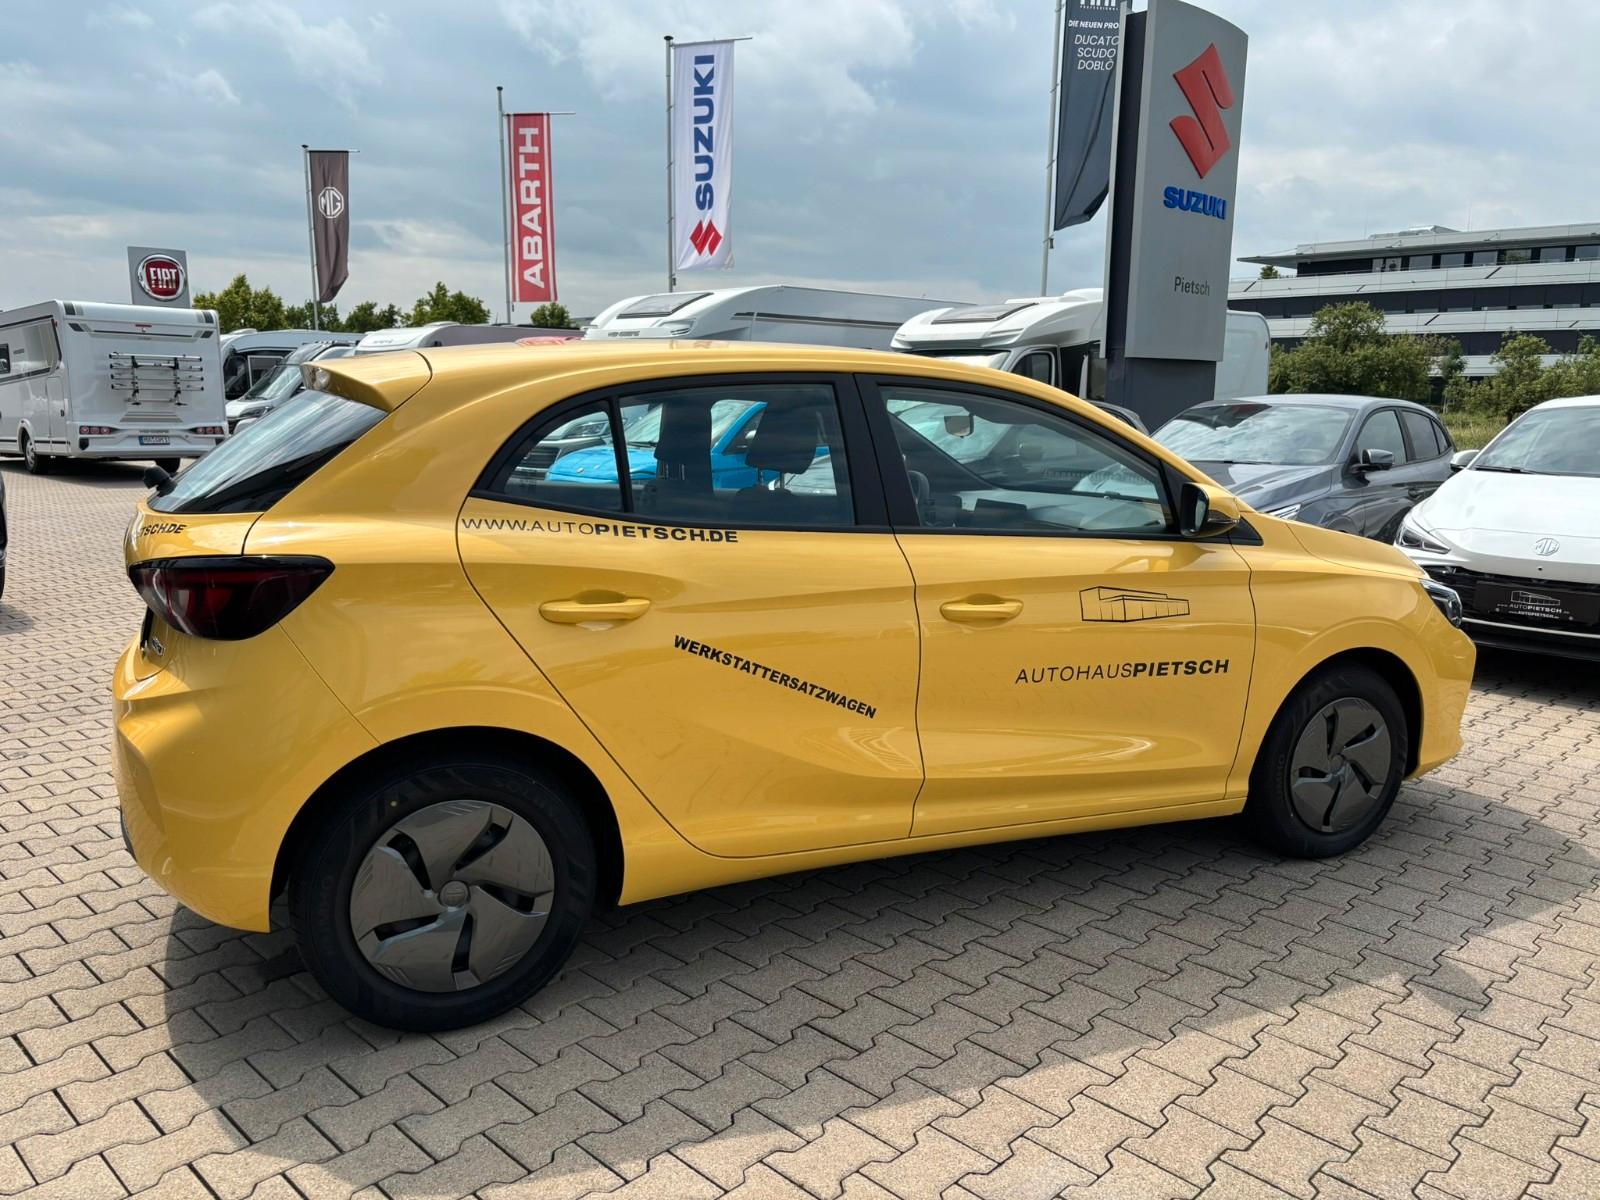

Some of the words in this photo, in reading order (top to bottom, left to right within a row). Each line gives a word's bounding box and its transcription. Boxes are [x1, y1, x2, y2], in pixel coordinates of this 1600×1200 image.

[1068, 20, 1079, 28] DIE
[1080, 21, 1103, 29] NEUEN
[1074, 34, 1120, 46] DUCATO
[1077, 47, 1116, 58] SCUDO
[693, 54, 715, 211] SUZUKI
[320, 188, 342, 217] MG
[518, 127, 545, 289] ABARTH
[1163, 186, 1227, 220] SUZUKI
[149, 267, 177, 289] FIAT
[1174, 276, 1210, 296] Pietsch
[461, 518, 738, 543] WWW.AUTOPIETSCH.DE
[674, 634, 877, 719] WERKSTATTERSATZWAGEN
[1015, 659, 1229, 684] AUTOHAUSPIETSCH
